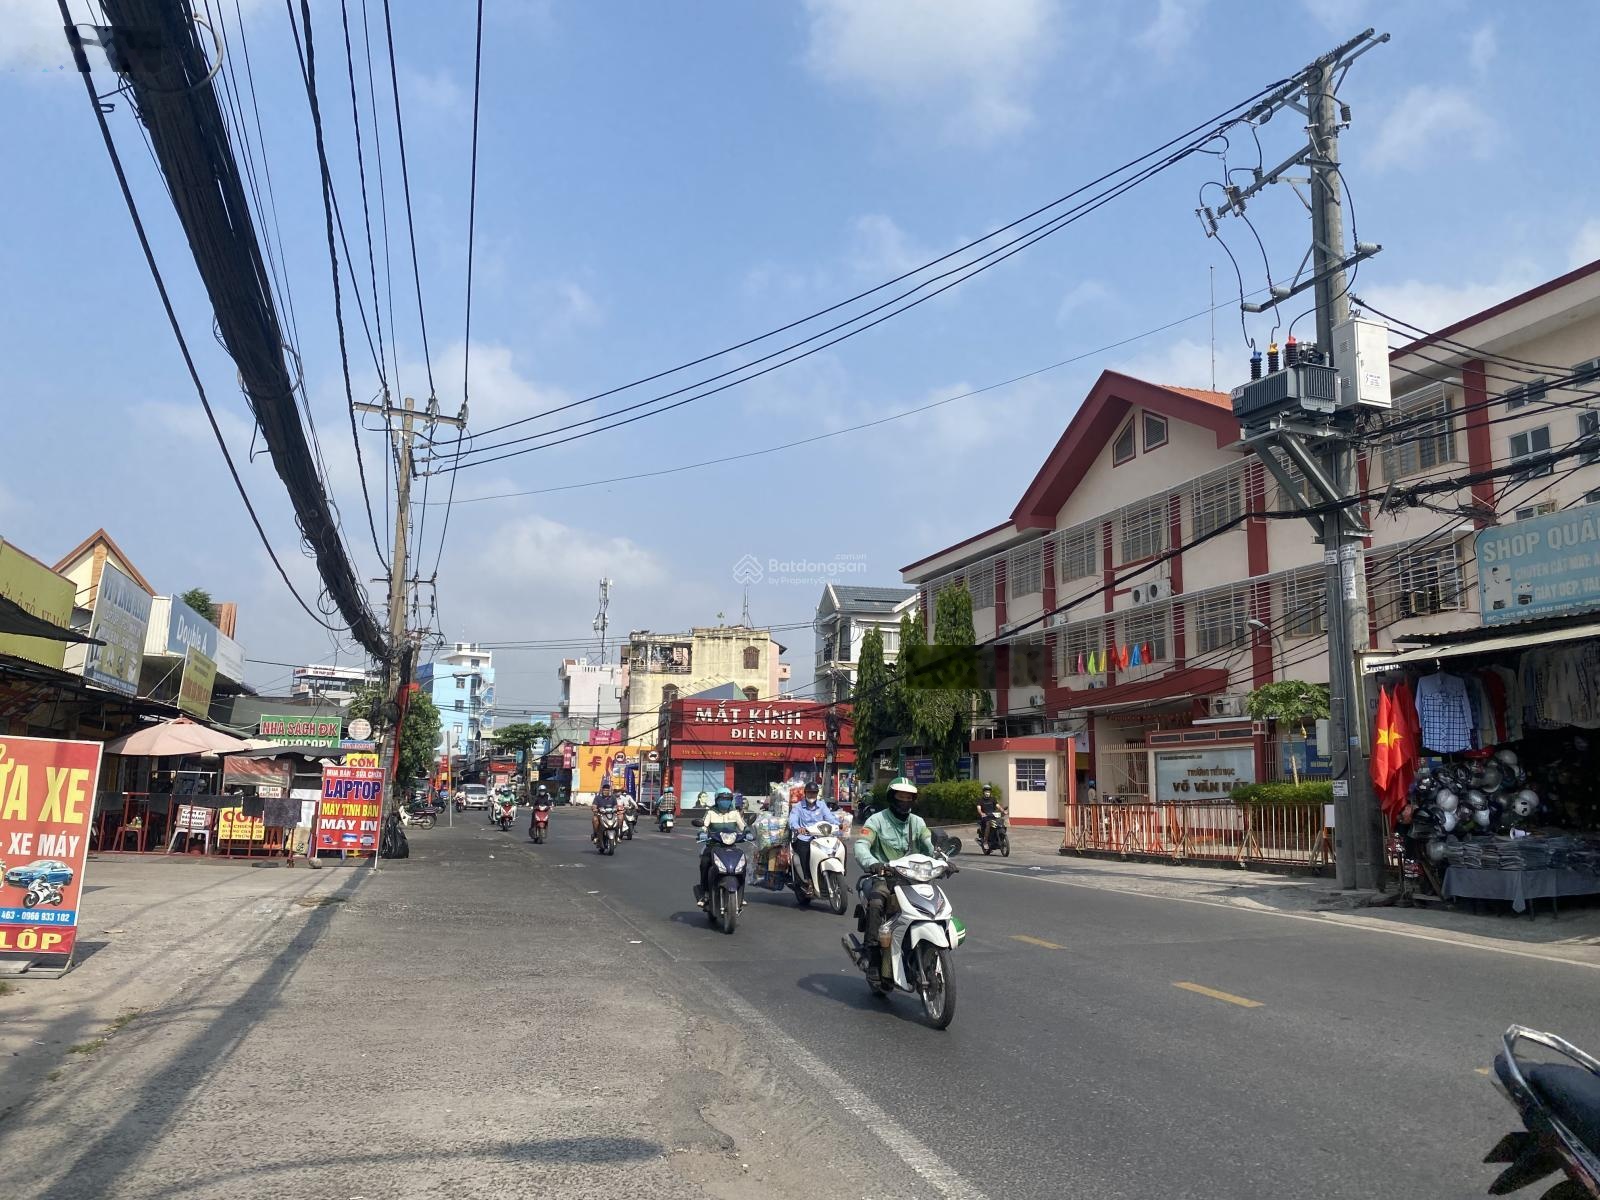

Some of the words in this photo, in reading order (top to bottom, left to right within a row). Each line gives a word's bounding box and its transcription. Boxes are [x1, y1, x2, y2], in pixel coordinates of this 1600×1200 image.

[1483, 532, 1539, 562] SHOP
[1548, 511, 1600, 551] QUẦ
[176, 614, 202, 650] Double
[694, 700, 741, 723] MẮT
[749, 705, 801, 725] KÍNH
[262, 718, 285, 736] NHÀ
[287, 718, 316, 736] SÁCH
[318, 721, 338, 737] ĐK
[731, 726, 766, 741] ĐIỆN
[770, 727, 804, 741] BIÊN
[38, 767, 89, 824] XE
[324, 779, 381, 800] LAPTOP
[1173, 779, 1190, 792] VÕ
[1194, 780, 1219, 793] VĂN
[322, 801, 340, 815] MÁY
[342, 802, 360, 816] TÍNH
[321, 817, 357, 830] MÁY
[360, 820, 378, 831] IN
[8, 832, 33, 855] XE
[37, 830, 80, 857] MÁY
[41, 912, 54, 921] 933
[57, 913, 70, 921] 102
[0, 926, 62, 950] LỐP
